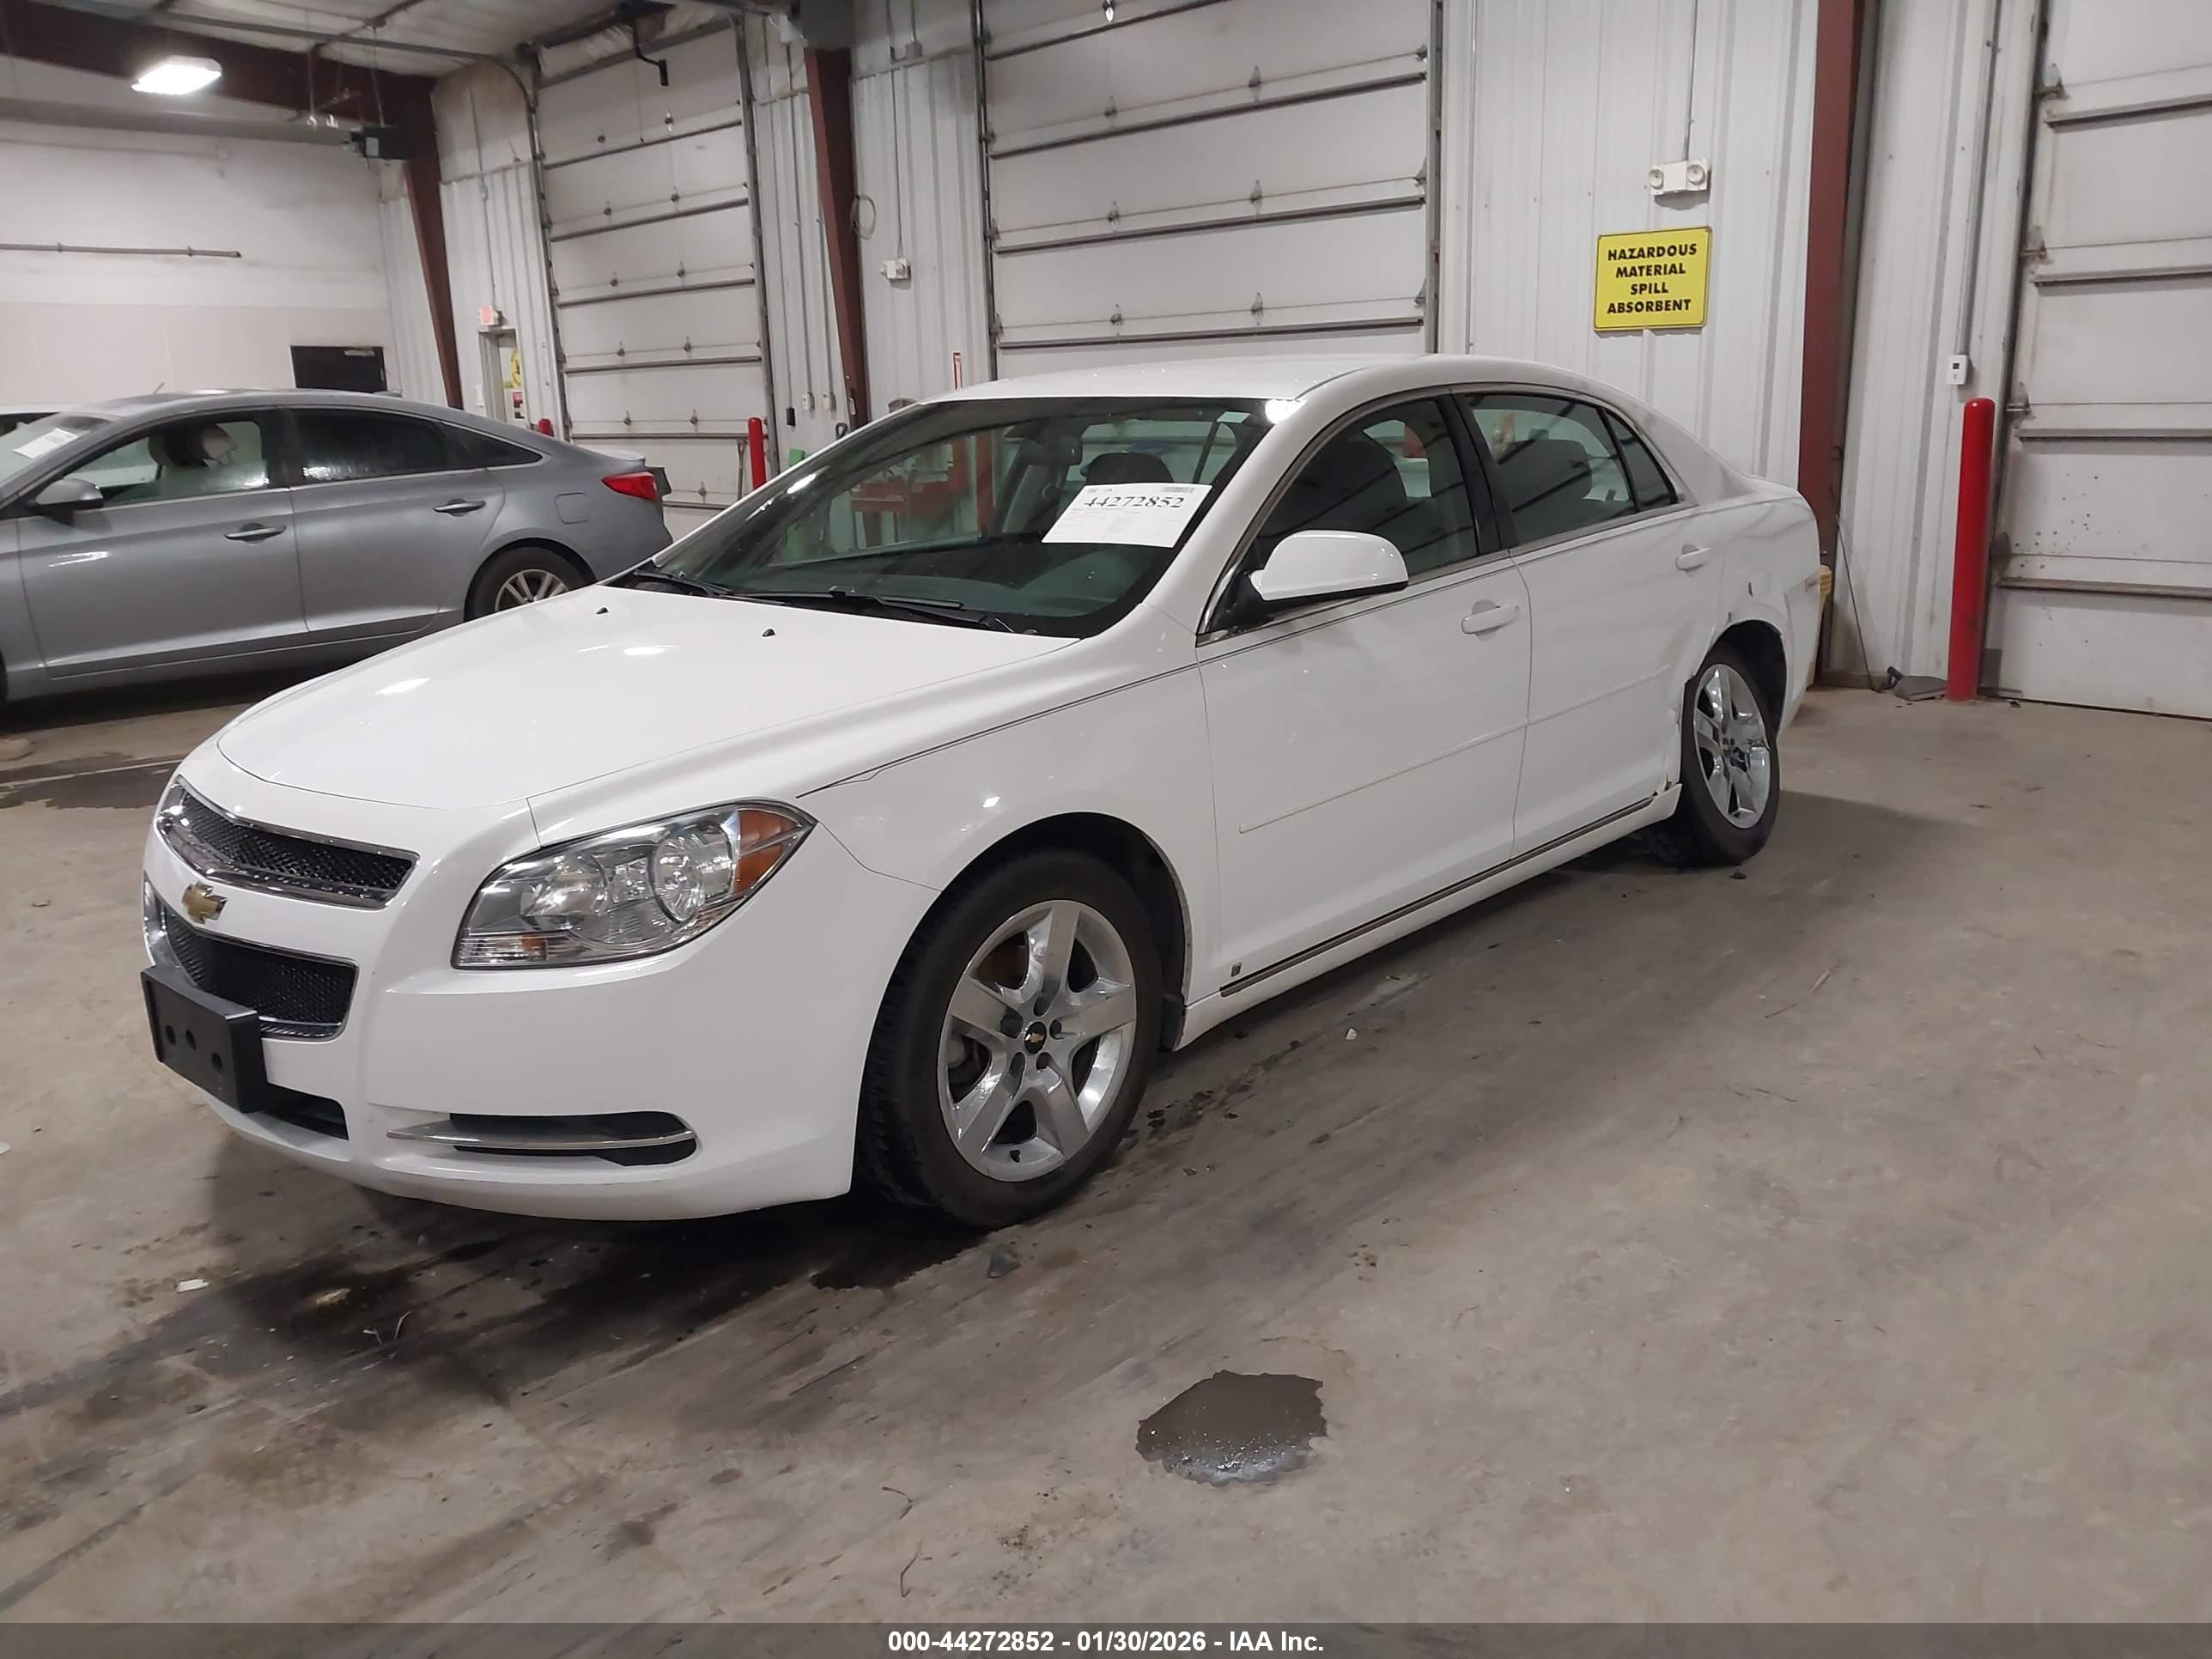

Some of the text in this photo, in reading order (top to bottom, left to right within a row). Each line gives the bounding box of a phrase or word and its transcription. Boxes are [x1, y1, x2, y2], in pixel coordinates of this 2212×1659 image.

[1607, 243, 1697, 261] HAZARDOUS
[1615, 263, 1686, 278] MATERIAL
[1630, 282, 1668, 295] SPILL
[1607, 299, 1692, 314] ABSORBENT
[1084, 495, 1185, 508] 44272852
